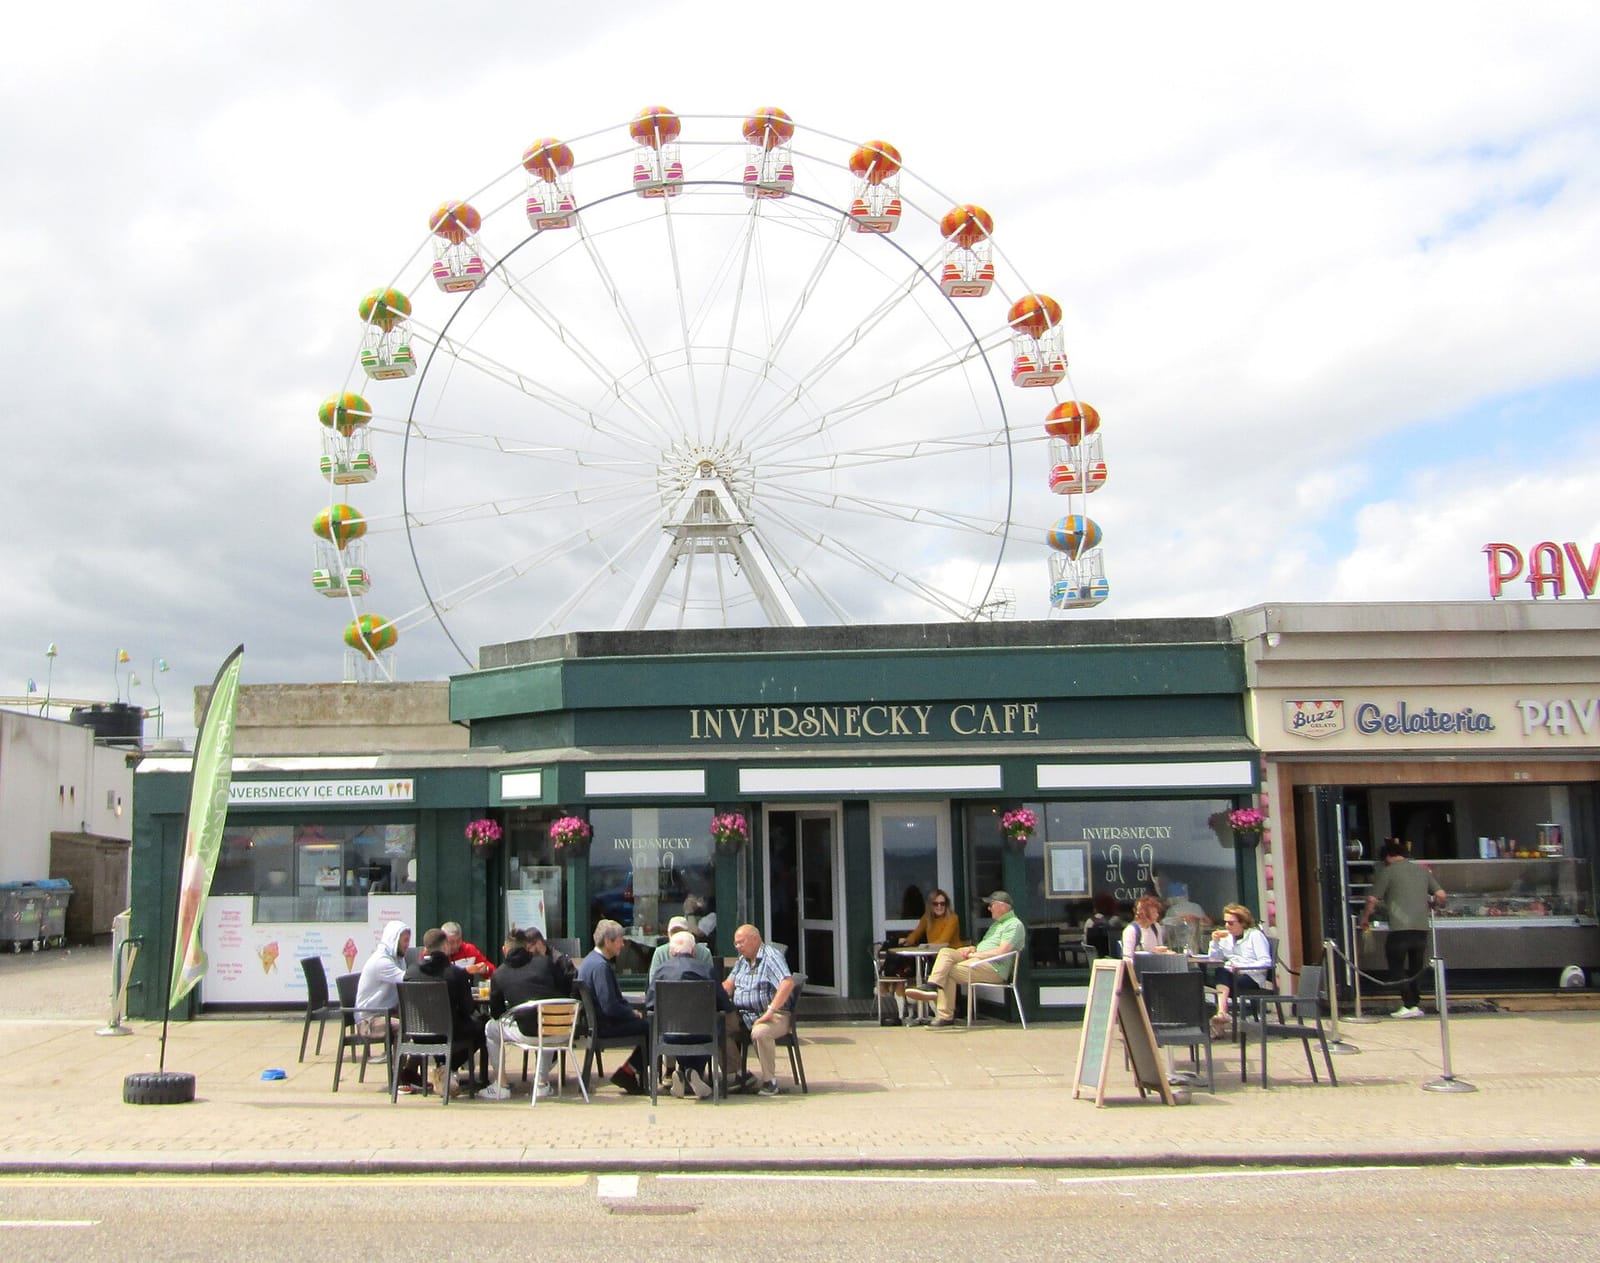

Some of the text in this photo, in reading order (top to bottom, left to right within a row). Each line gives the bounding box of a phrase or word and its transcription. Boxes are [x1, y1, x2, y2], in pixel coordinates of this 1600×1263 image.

[690, 702, 1040, 739] INVERSNECKY CAFE
[1293, 710, 1335, 729] Buzz
[1356, 701, 1496, 734] Gelateria
[228, 785, 384, 799] NVERSNECKY ICE CREAM
[1082, 826, 1171, 840] INVERSNECKY
[614, 837, 692, 849] INVERSNECKY
